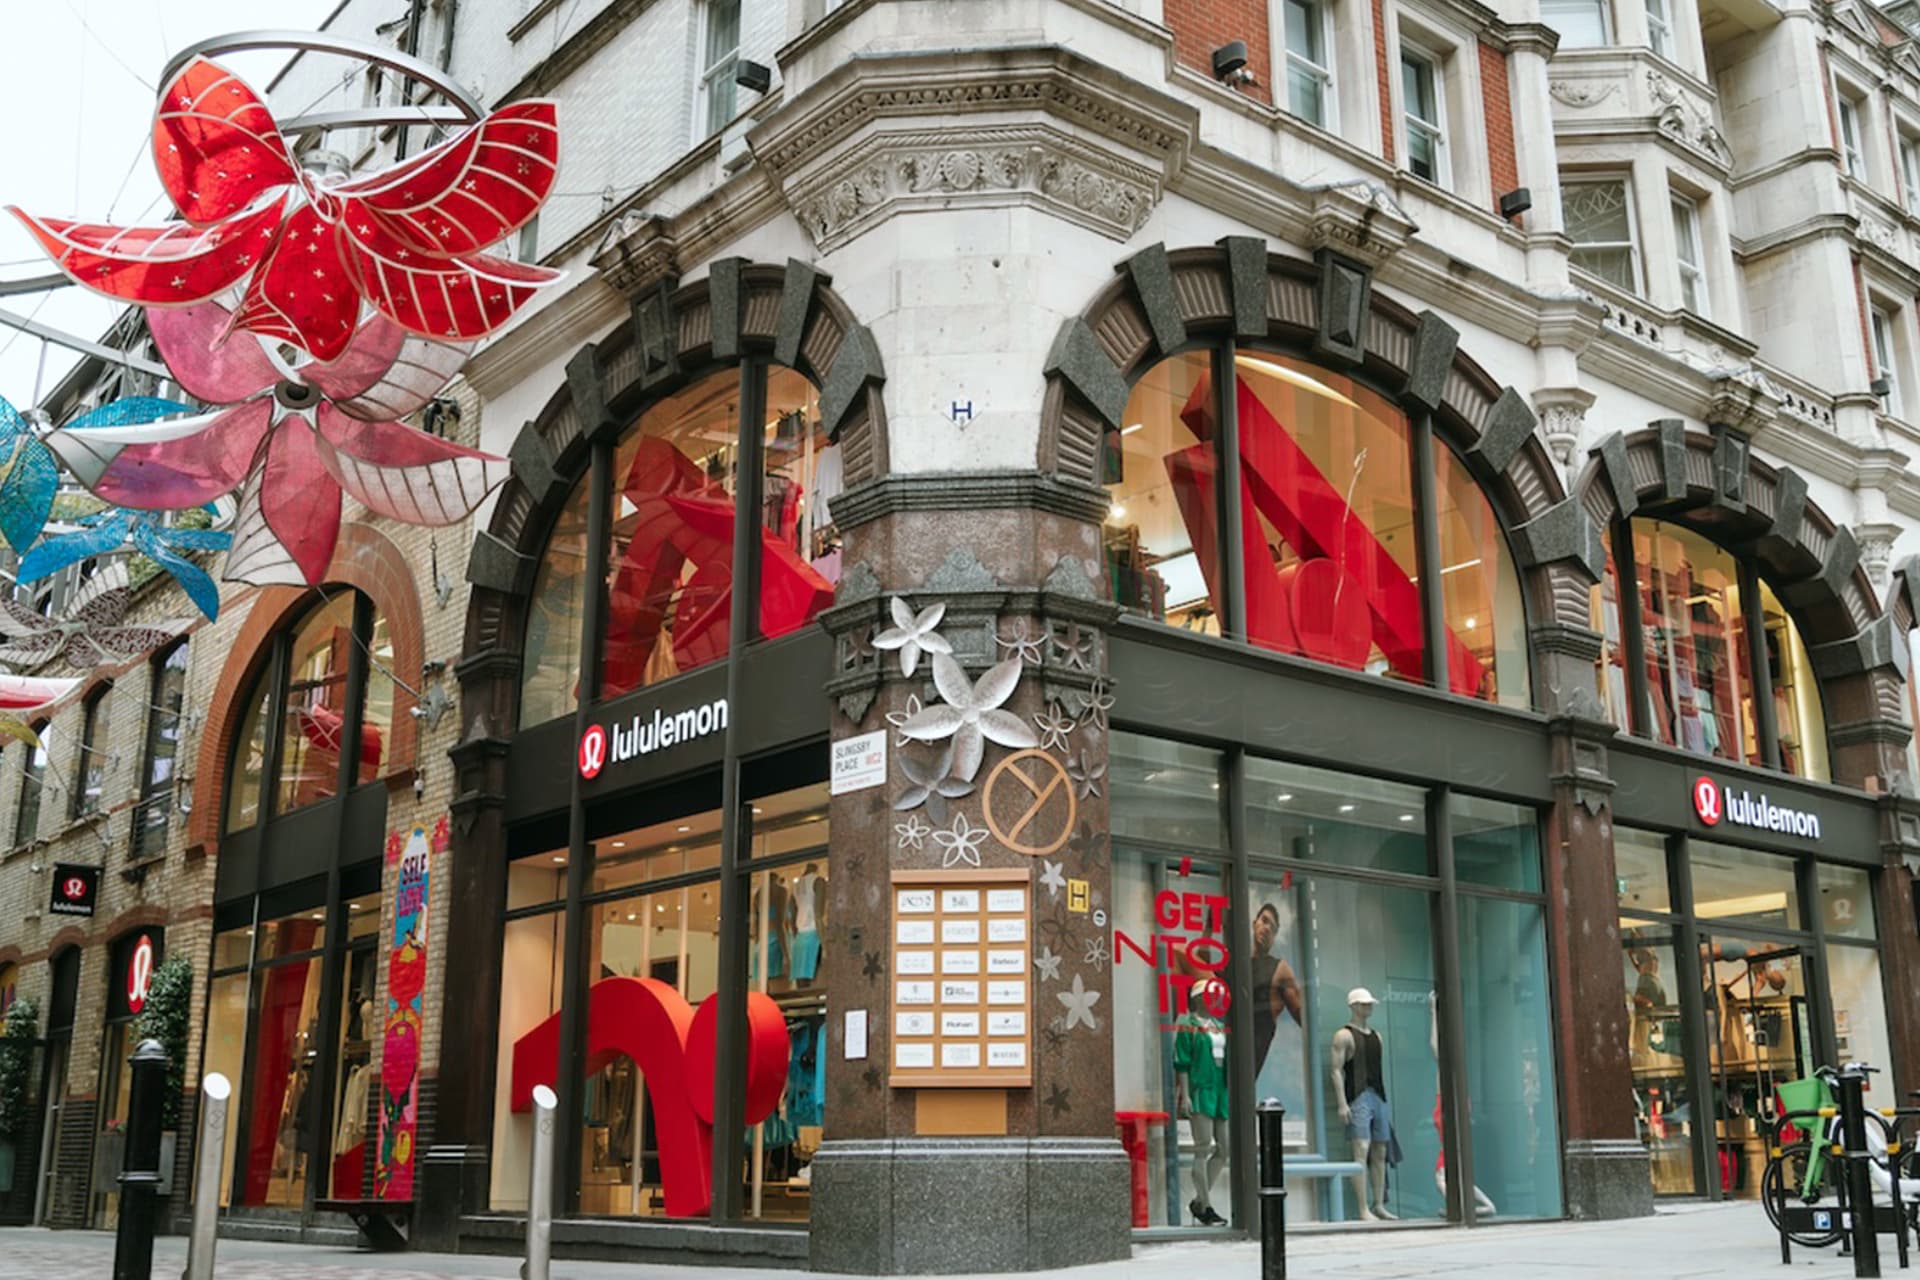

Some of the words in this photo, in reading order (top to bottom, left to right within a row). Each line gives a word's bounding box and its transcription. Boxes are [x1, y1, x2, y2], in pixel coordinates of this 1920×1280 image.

[952, 401, 972, 420] H
[611, 699, 729, 762] lululemon
[835, 740, 871, 759] SLINGSBY
[835, 757, 859, 772] PLACE
[1724, 786, 1820, 839] lululemon
[403, 853, 427, 885] SELF
[399, 885, 425, 917] LOVE
[1070, 883, 1087, 908] H
[1154, 888, 1230, 935] GET
